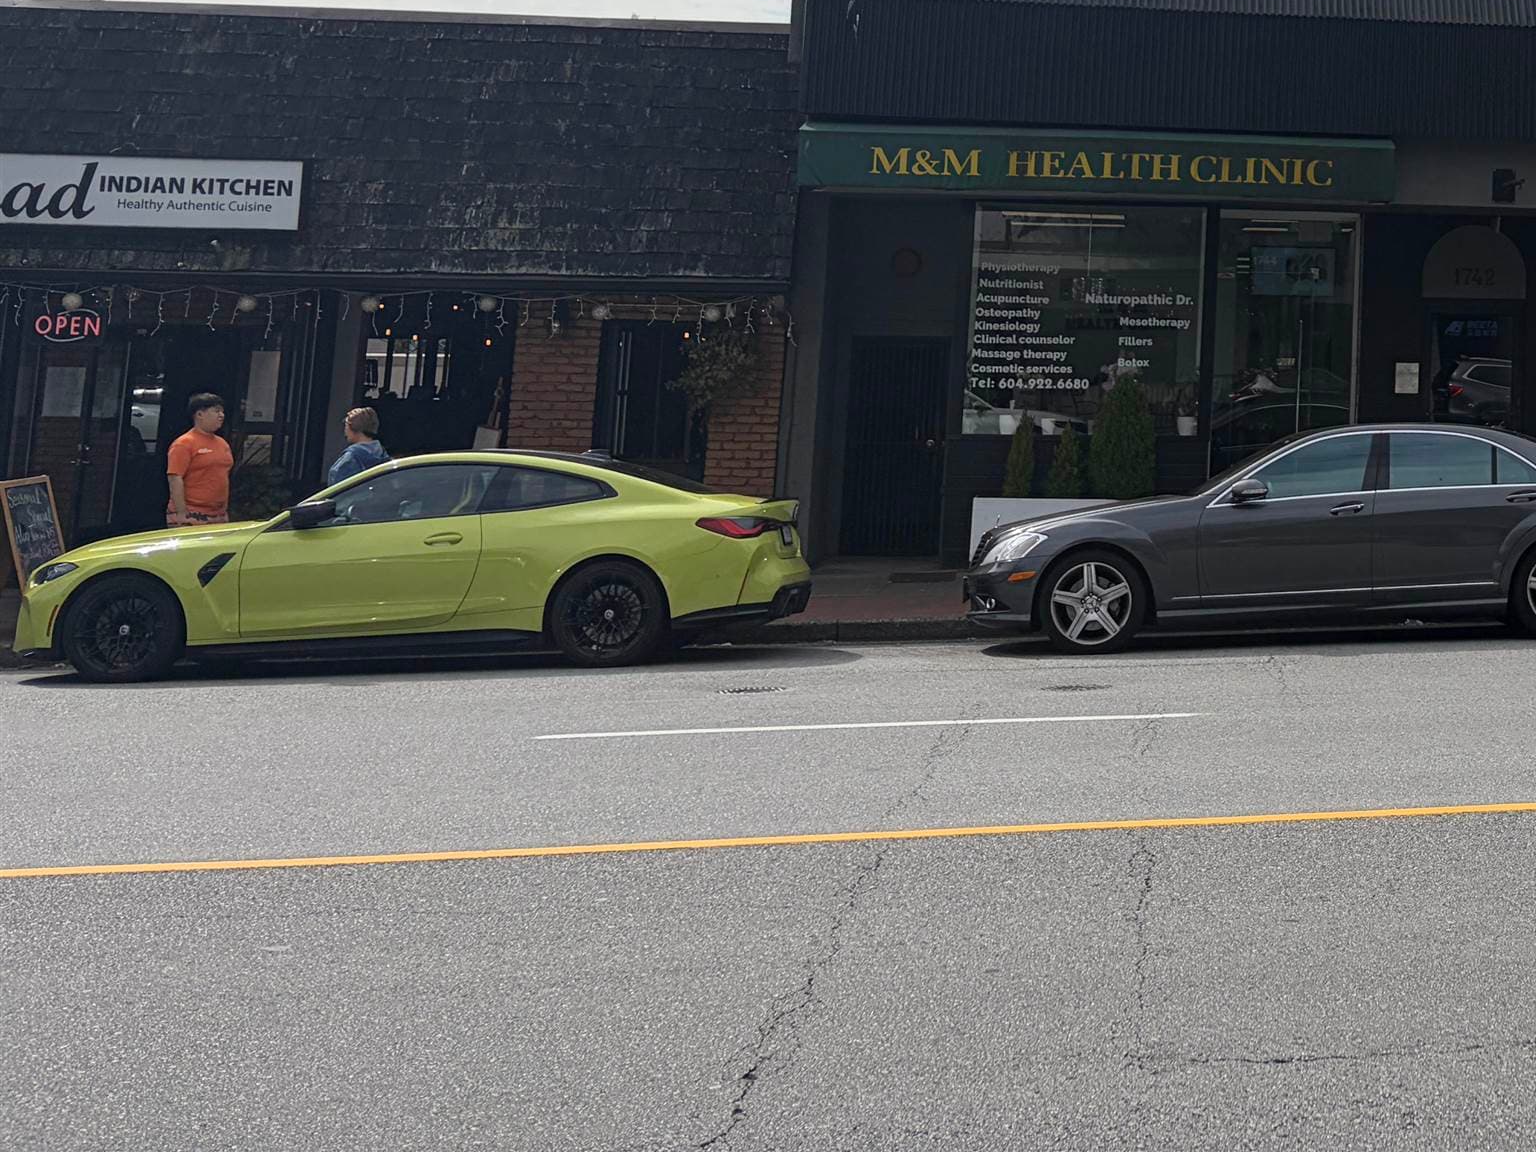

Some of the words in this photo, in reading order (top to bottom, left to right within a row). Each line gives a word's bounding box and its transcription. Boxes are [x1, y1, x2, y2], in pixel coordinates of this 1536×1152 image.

[869, 146, 981, 177] M&M
[1006, 150, 1182, 181] HEALTH
[1190, 155, 1333, 186] CLINIC
[99, 175, 185, 194] INDIAN
[191, 178, 293, 197] KITCHEN
[117, 199, 163, 212] Healthy
[167, 199, 226, 213] Authentic
[228, 201, 272, 213] Cuisine
[981, 262, 1060, 274] Physiotherapy
[1454, 268, 1496, 286] 1742
[979, 279, 1044, 289] Nutritionist
[976, 293, 1050, 305] Acupuncture
[1085, 293, 1173, 307] Naturopathic
[1176, 294, 1194, 305] Dr.
[975, 308, 1040, 320] Osteopathy
[35, 315, 101, 336] OPEN
[974, 321, 1040, 333] Kinesiology
[1120, 316, 1191, 329] Mesotherapy
[973, 335, 1017, 344] Clinical
[1018, 335, 1076, 345] counselor
[1118, 337, 1153, 346] Fillers
[971, 349, 1021, 360] Massage
[1023, 349, 1067, 361] therapy
[1117, 358, 1150, 367] Botox
[971, 364, 1024, 374] Cosmetic
[1025, 364, 1073, 374] services
[970, 377, 995, 389] Tel:
[998, 378, 1090, 389] 604.922.6680
